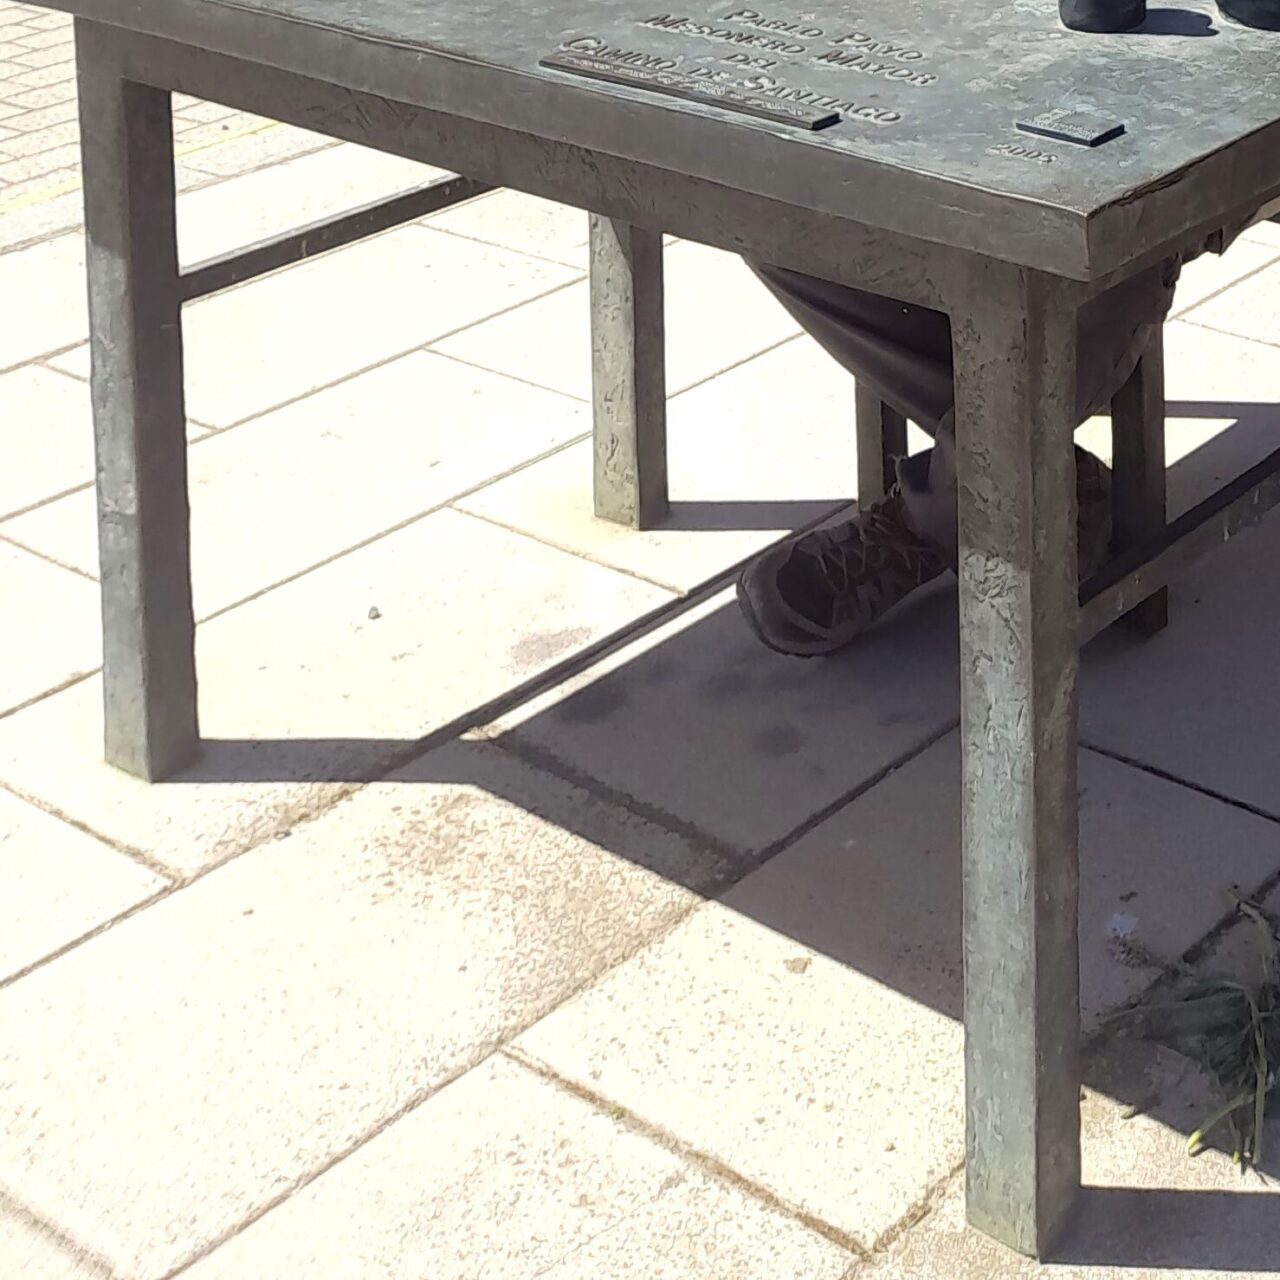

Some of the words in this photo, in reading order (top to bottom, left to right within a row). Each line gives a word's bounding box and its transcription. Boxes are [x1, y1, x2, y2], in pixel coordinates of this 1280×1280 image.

[641, 14, 806, 54] MESONERO
[812, 48, 938, 86] MAYOR
[722, 52, 777, 71] DEL
[724, 8, 824, 39] PABLO
[830, 31, 925, 61] PAYO
[561, 36, 680, 70] CAMINO
[744, 74, 902, 124] SANTIAGO
